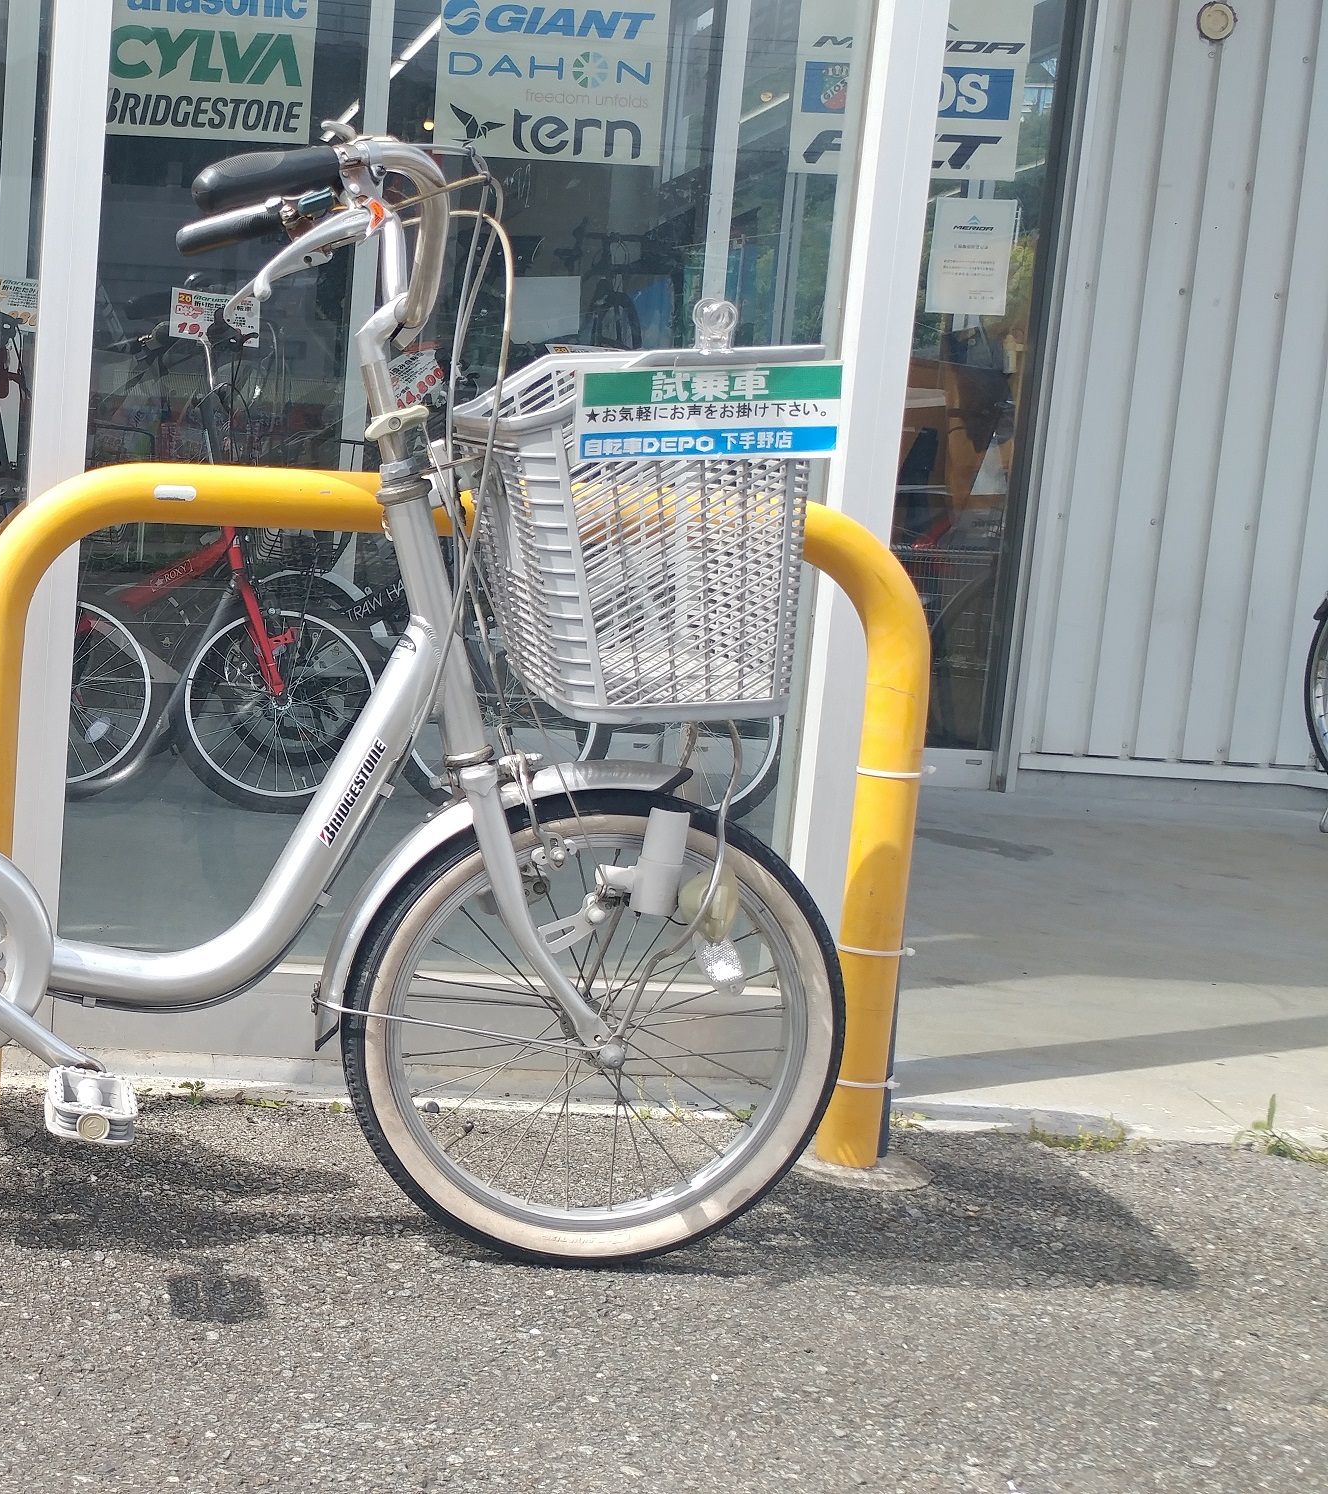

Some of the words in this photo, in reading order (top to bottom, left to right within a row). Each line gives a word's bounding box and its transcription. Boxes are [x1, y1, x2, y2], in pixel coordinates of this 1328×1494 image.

[484, 4, 656, 40] GIANT
[109, 24, 303, 88] CYLVA
[106, 87, 304, 134] BRIDGESTONE
[525, 88, 591, 106] freedom
[595, 93, 649, 109] unfolds
[512, 107, 643, 160] tern
[179, 294, 192, 302] 20
[650, 370, 770, 403] 試乗車
[601, 402, 828, 423] お気軽にお声をお掛け下さい。
[583, 435, 715, 457] 自転車DEPO
[721, 430, 794, 451] 下手野店
[163, 561, 188, 583] ROXY
[323, 739, 388, 848] BRIDGESTONE
